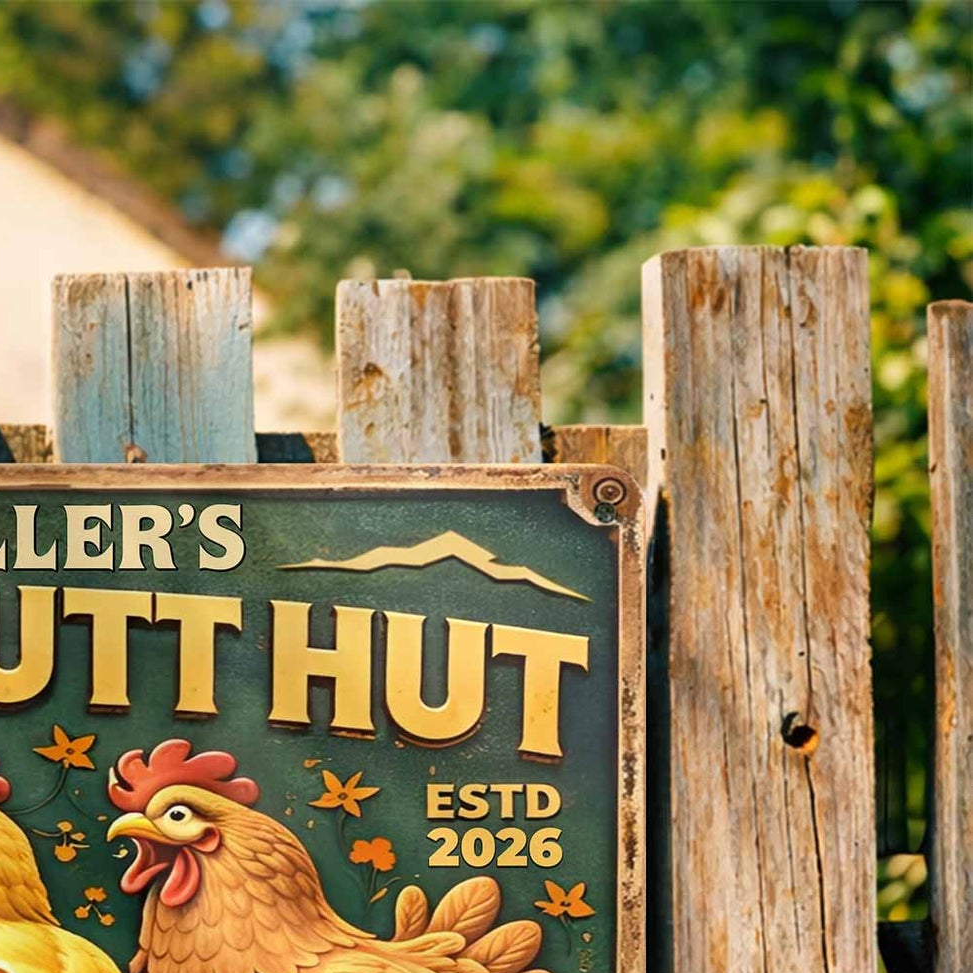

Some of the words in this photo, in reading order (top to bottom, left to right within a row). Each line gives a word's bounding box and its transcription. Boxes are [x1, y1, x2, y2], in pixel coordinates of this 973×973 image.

[267, 598, 591, 760] HUT
[425, 782, 563, 821] ESTD
[425, 826, 564, 869] 2026
